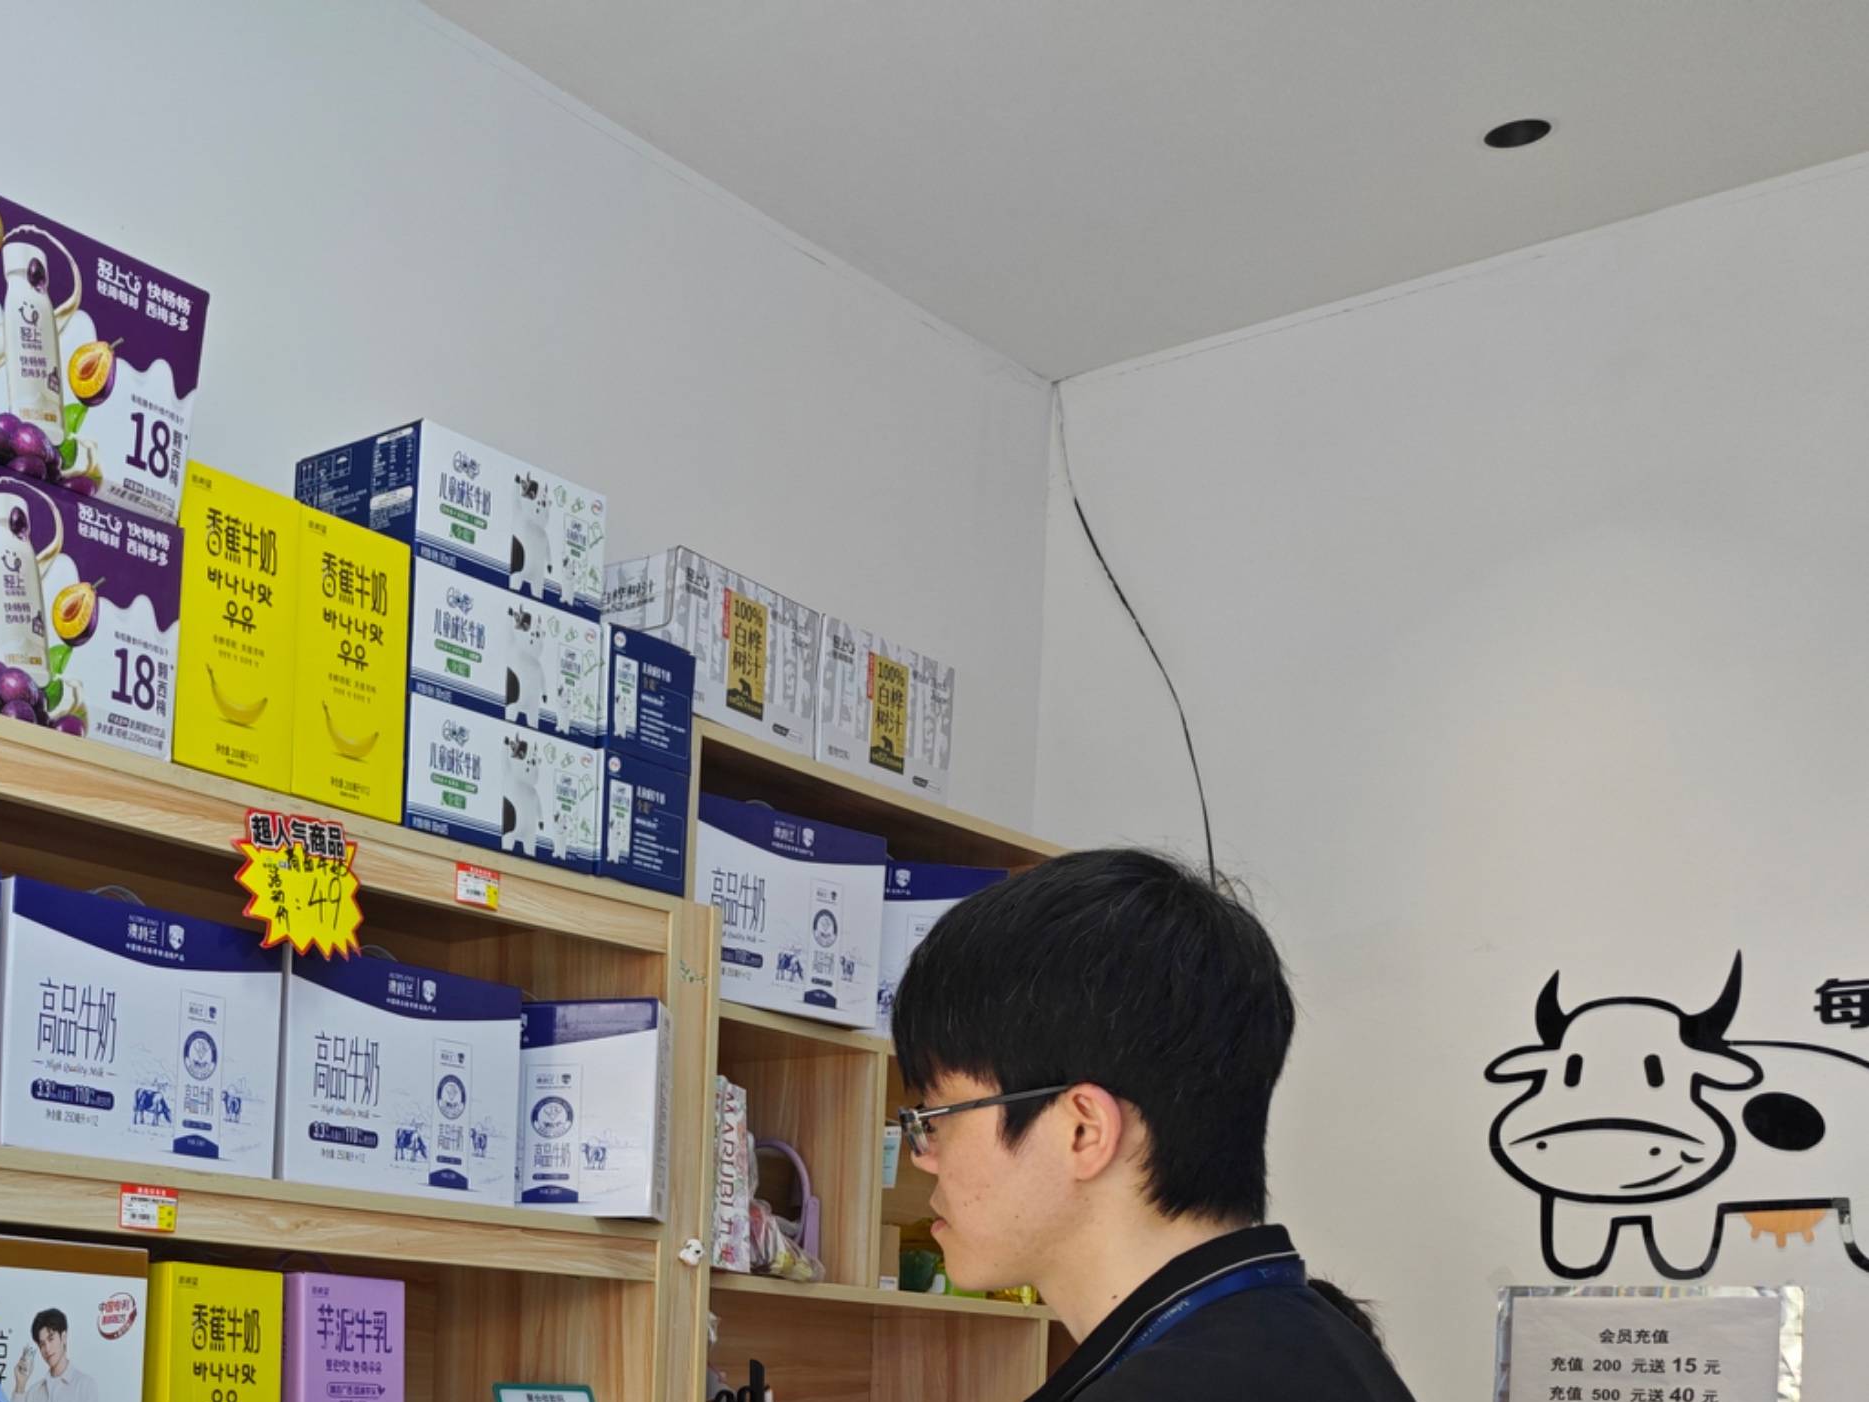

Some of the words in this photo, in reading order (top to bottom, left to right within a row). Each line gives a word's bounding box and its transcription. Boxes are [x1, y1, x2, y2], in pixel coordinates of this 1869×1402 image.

[126, 412, 170, 478] 18
[205, 506, 278, 578] 香蕉牛奶
[207, 565, 273, 609] 바나나맛
[323, 606, 384, 647] 바나나맛
[733, 599, 763, 627] 100%
[112, 648, 155, 711] 18
[252, 814, 345, 857] 超人气商品
[37, 977, 118, 1066] 高品牛奶
[312, 1031, 381, 1107] 高品牛奶
[191, 1303, 261, 1355] 香蕉牛奶
[316, 1303, 393, 1355] 芋泥牛乳
[1599, 1328, 1670, 1345] 会员充值
[192, 1361, 257, 1386] 바나나맛
[1551, 1358, 1584, 1374] 充值
[1593, 1359, 1622, 1373] 200
[1632, 1358, 1666, 1375] 元送
[1672, 1356, 1698, 1374] 15
[1704, 1359, 1722, 1375] 元
[1550, 1386, 1582, 1402] 充值
[1592, 1388, 1621, 1402] 500
